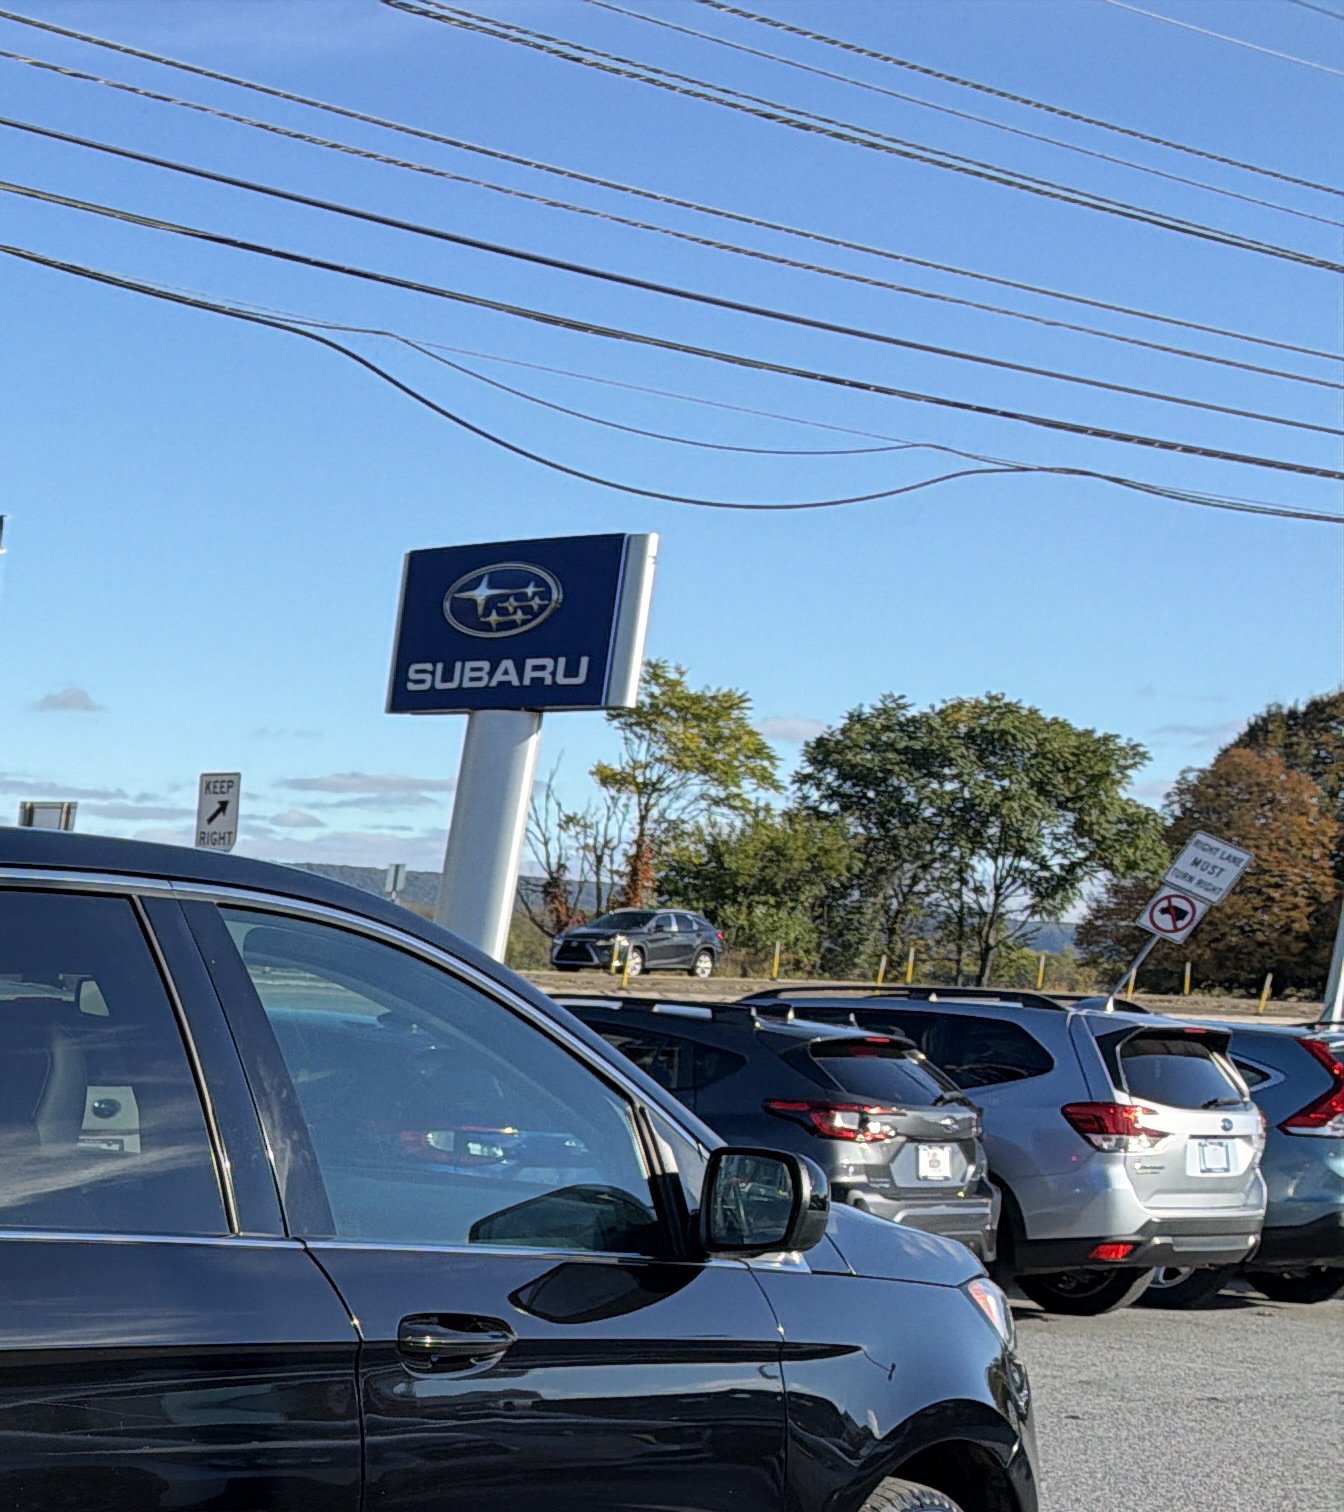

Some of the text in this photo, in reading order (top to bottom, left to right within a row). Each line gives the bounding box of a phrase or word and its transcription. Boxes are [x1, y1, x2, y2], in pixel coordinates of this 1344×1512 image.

[406, 655, 590, 691] SUBARU
[204, 780, 234, 795] KEEP
[199, 831, 233, 846] RIGHT
[1190, 857, 1226, 878] MUST
